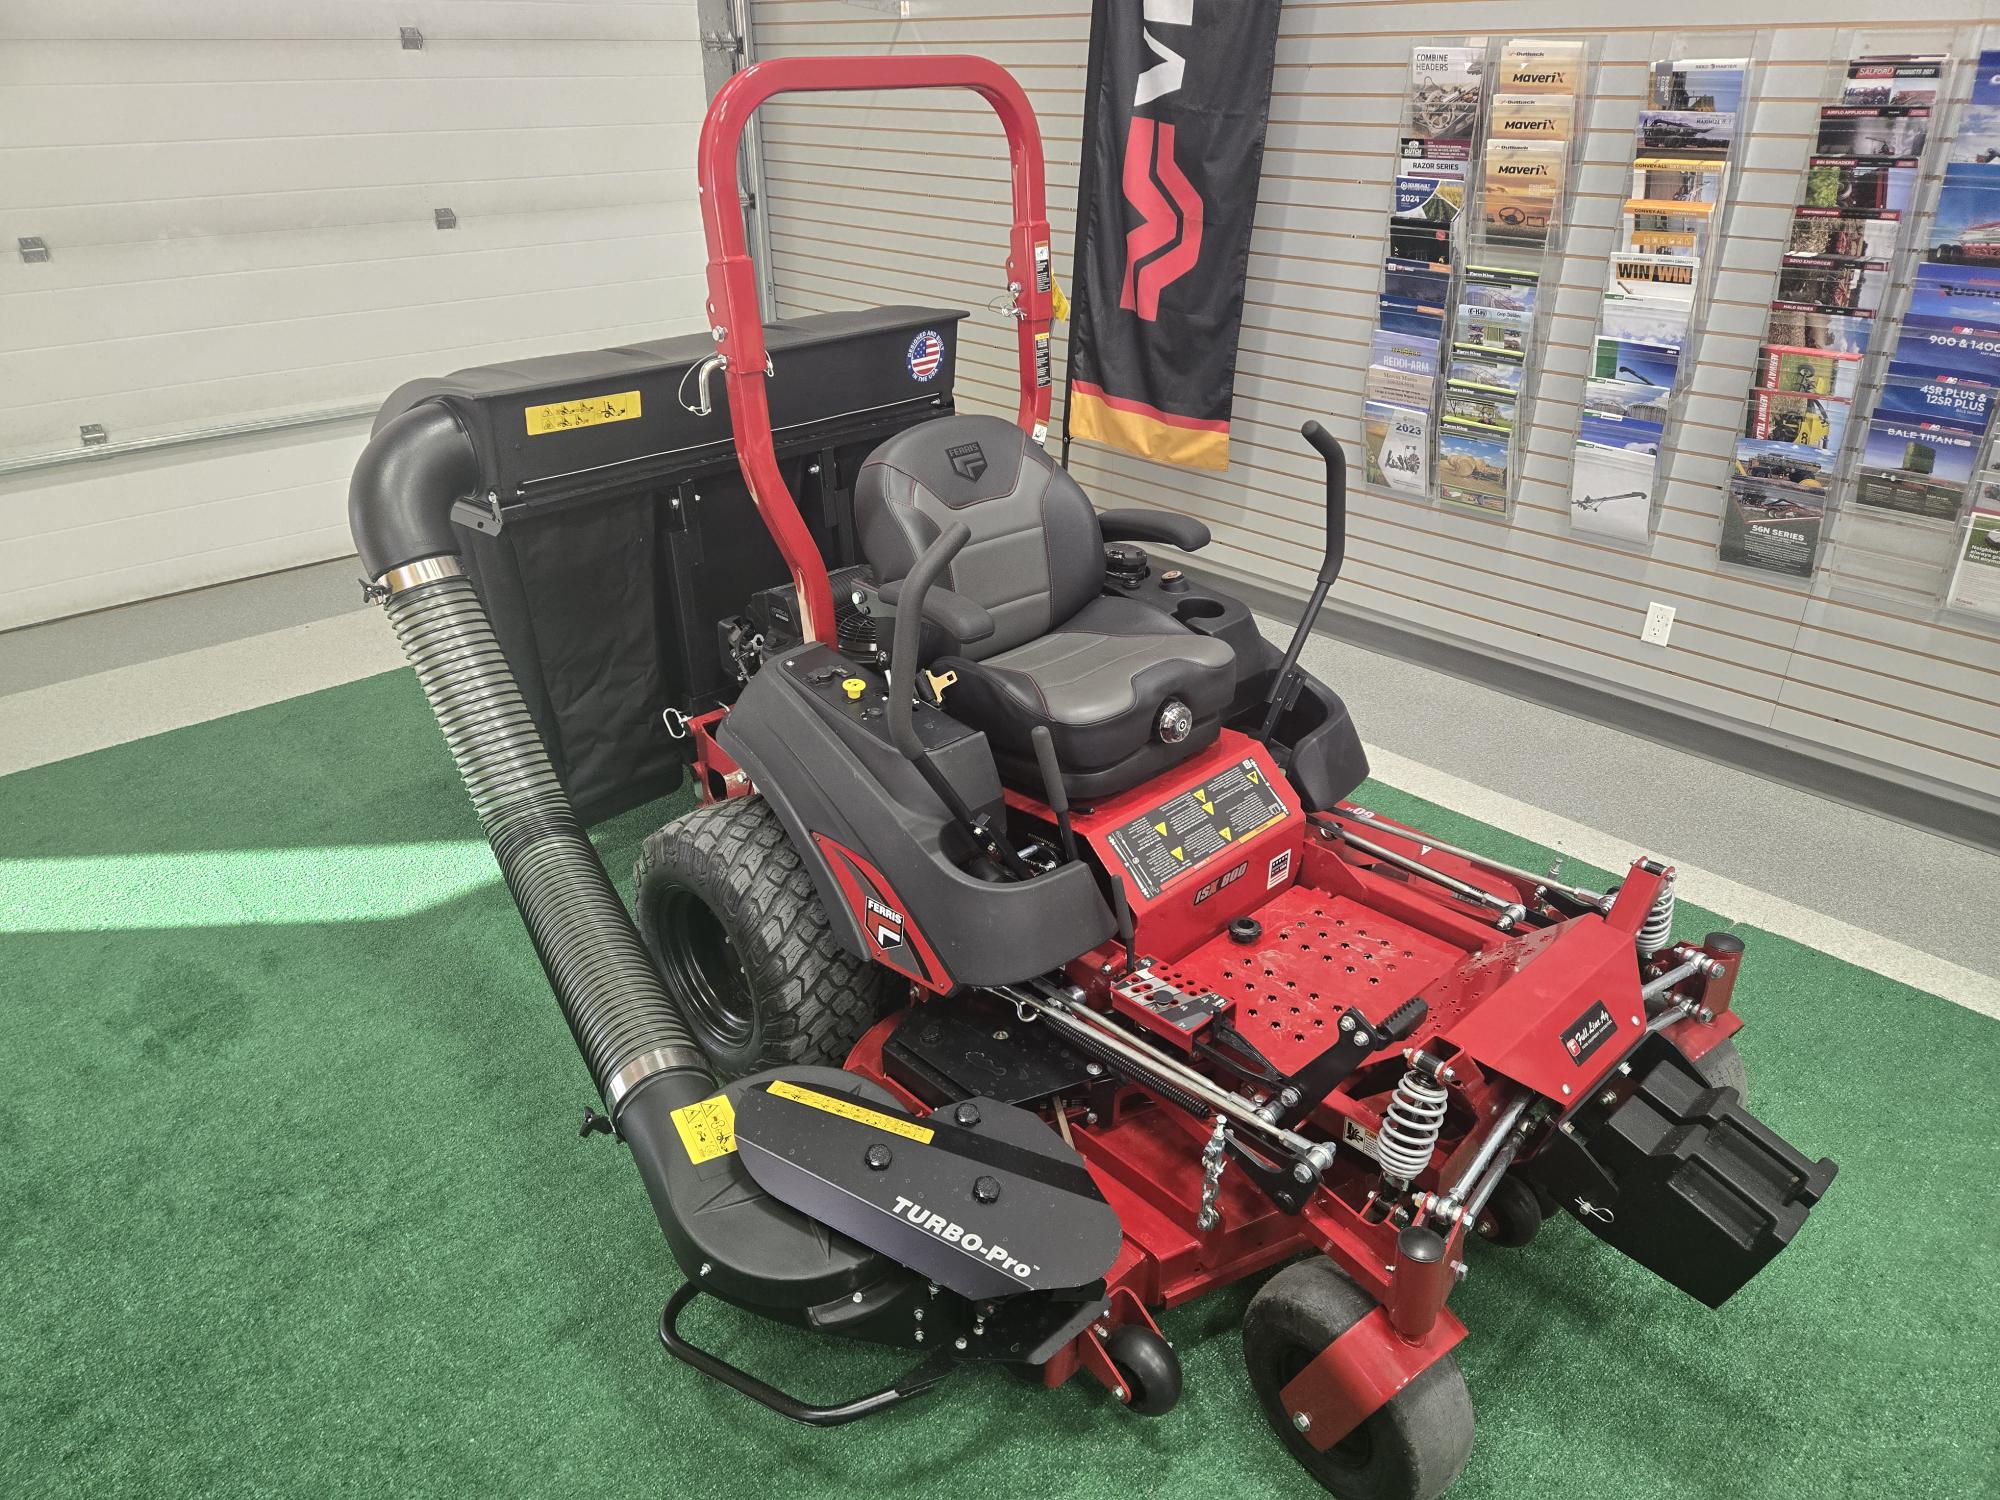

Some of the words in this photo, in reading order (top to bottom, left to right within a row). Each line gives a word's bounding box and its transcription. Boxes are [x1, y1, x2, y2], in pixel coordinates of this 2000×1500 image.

[1416, 53, 1449, 62] COMBINE
[1416, 63, 1449, 71] HEADERS
[1859, 67, 1894, 75] SALFORD
[1412, 162, 1435, 170] RAZOR
[1436, 163, 1459, 171] SERIES
[1400, 195, 1420, 203] 2024
[1618, 263, 1650, 279] WIN
[1660, 266, 1690, 283] WIN
[936, 334, 945, 351] BUILT
[1930, 335, 1957, 346] 900
[1959, 339, 1968, 348] &
[1383, 355, 1429, 373] REDDI-ARM
[1920, 384, 1943, 395] 4SR
[1945, 388, 1976, 401] PLUS
[1977, 393, 1987, 403] &
[1926, 394, 1953, 406] 12SR
[1954, 399, 1985, 412] PLUS
[1396, 422, 1421, 435] 2023
[1887, 428, 1918, 439] BALE
[1919, 433, 1952, 445] TITAN
[949, 443, 978, 457] FERRIS
[1772, 529, 1805, 541] SERIES
[1195, 879, 1220, 905] ISX
[1220, 862, 1248, 888] 800
[868, 899, 903, 925] FERRIS
